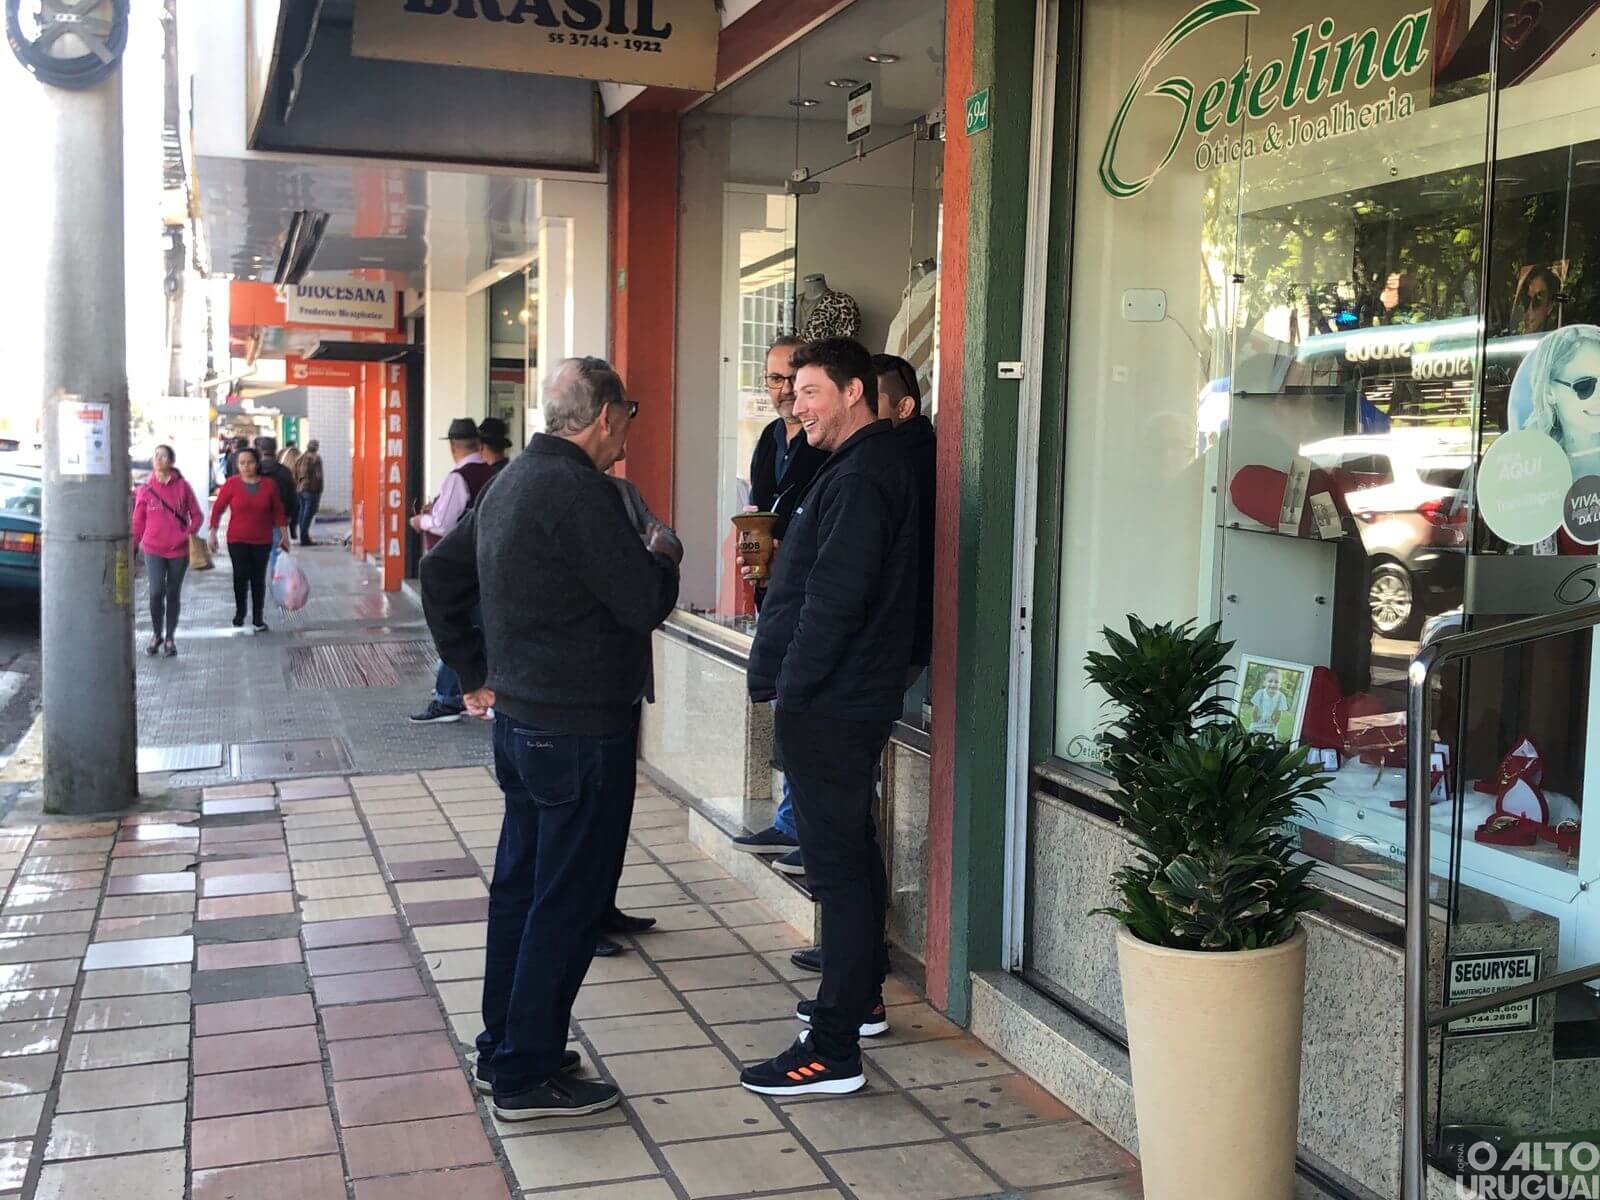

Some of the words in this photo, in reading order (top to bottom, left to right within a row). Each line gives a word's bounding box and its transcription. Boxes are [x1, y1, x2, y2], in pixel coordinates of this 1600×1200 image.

[548, 32, 565, 44] 55
[569, 32, 608, 49] 3744
[624, 38, 662, 53] 1922
[966, 97, 987, 129] 694
[1195, 134, 1254, 172] Ótica
[1262, 123, 1283, 154] &
[1287, 87, 1414, 148] Joalheria
[296, 285, 386, 304] DIOCESANA
[387, 364, 403, 556] FARMÁCIA
[1455, 959, 1532, 982] SEGURYSEL
